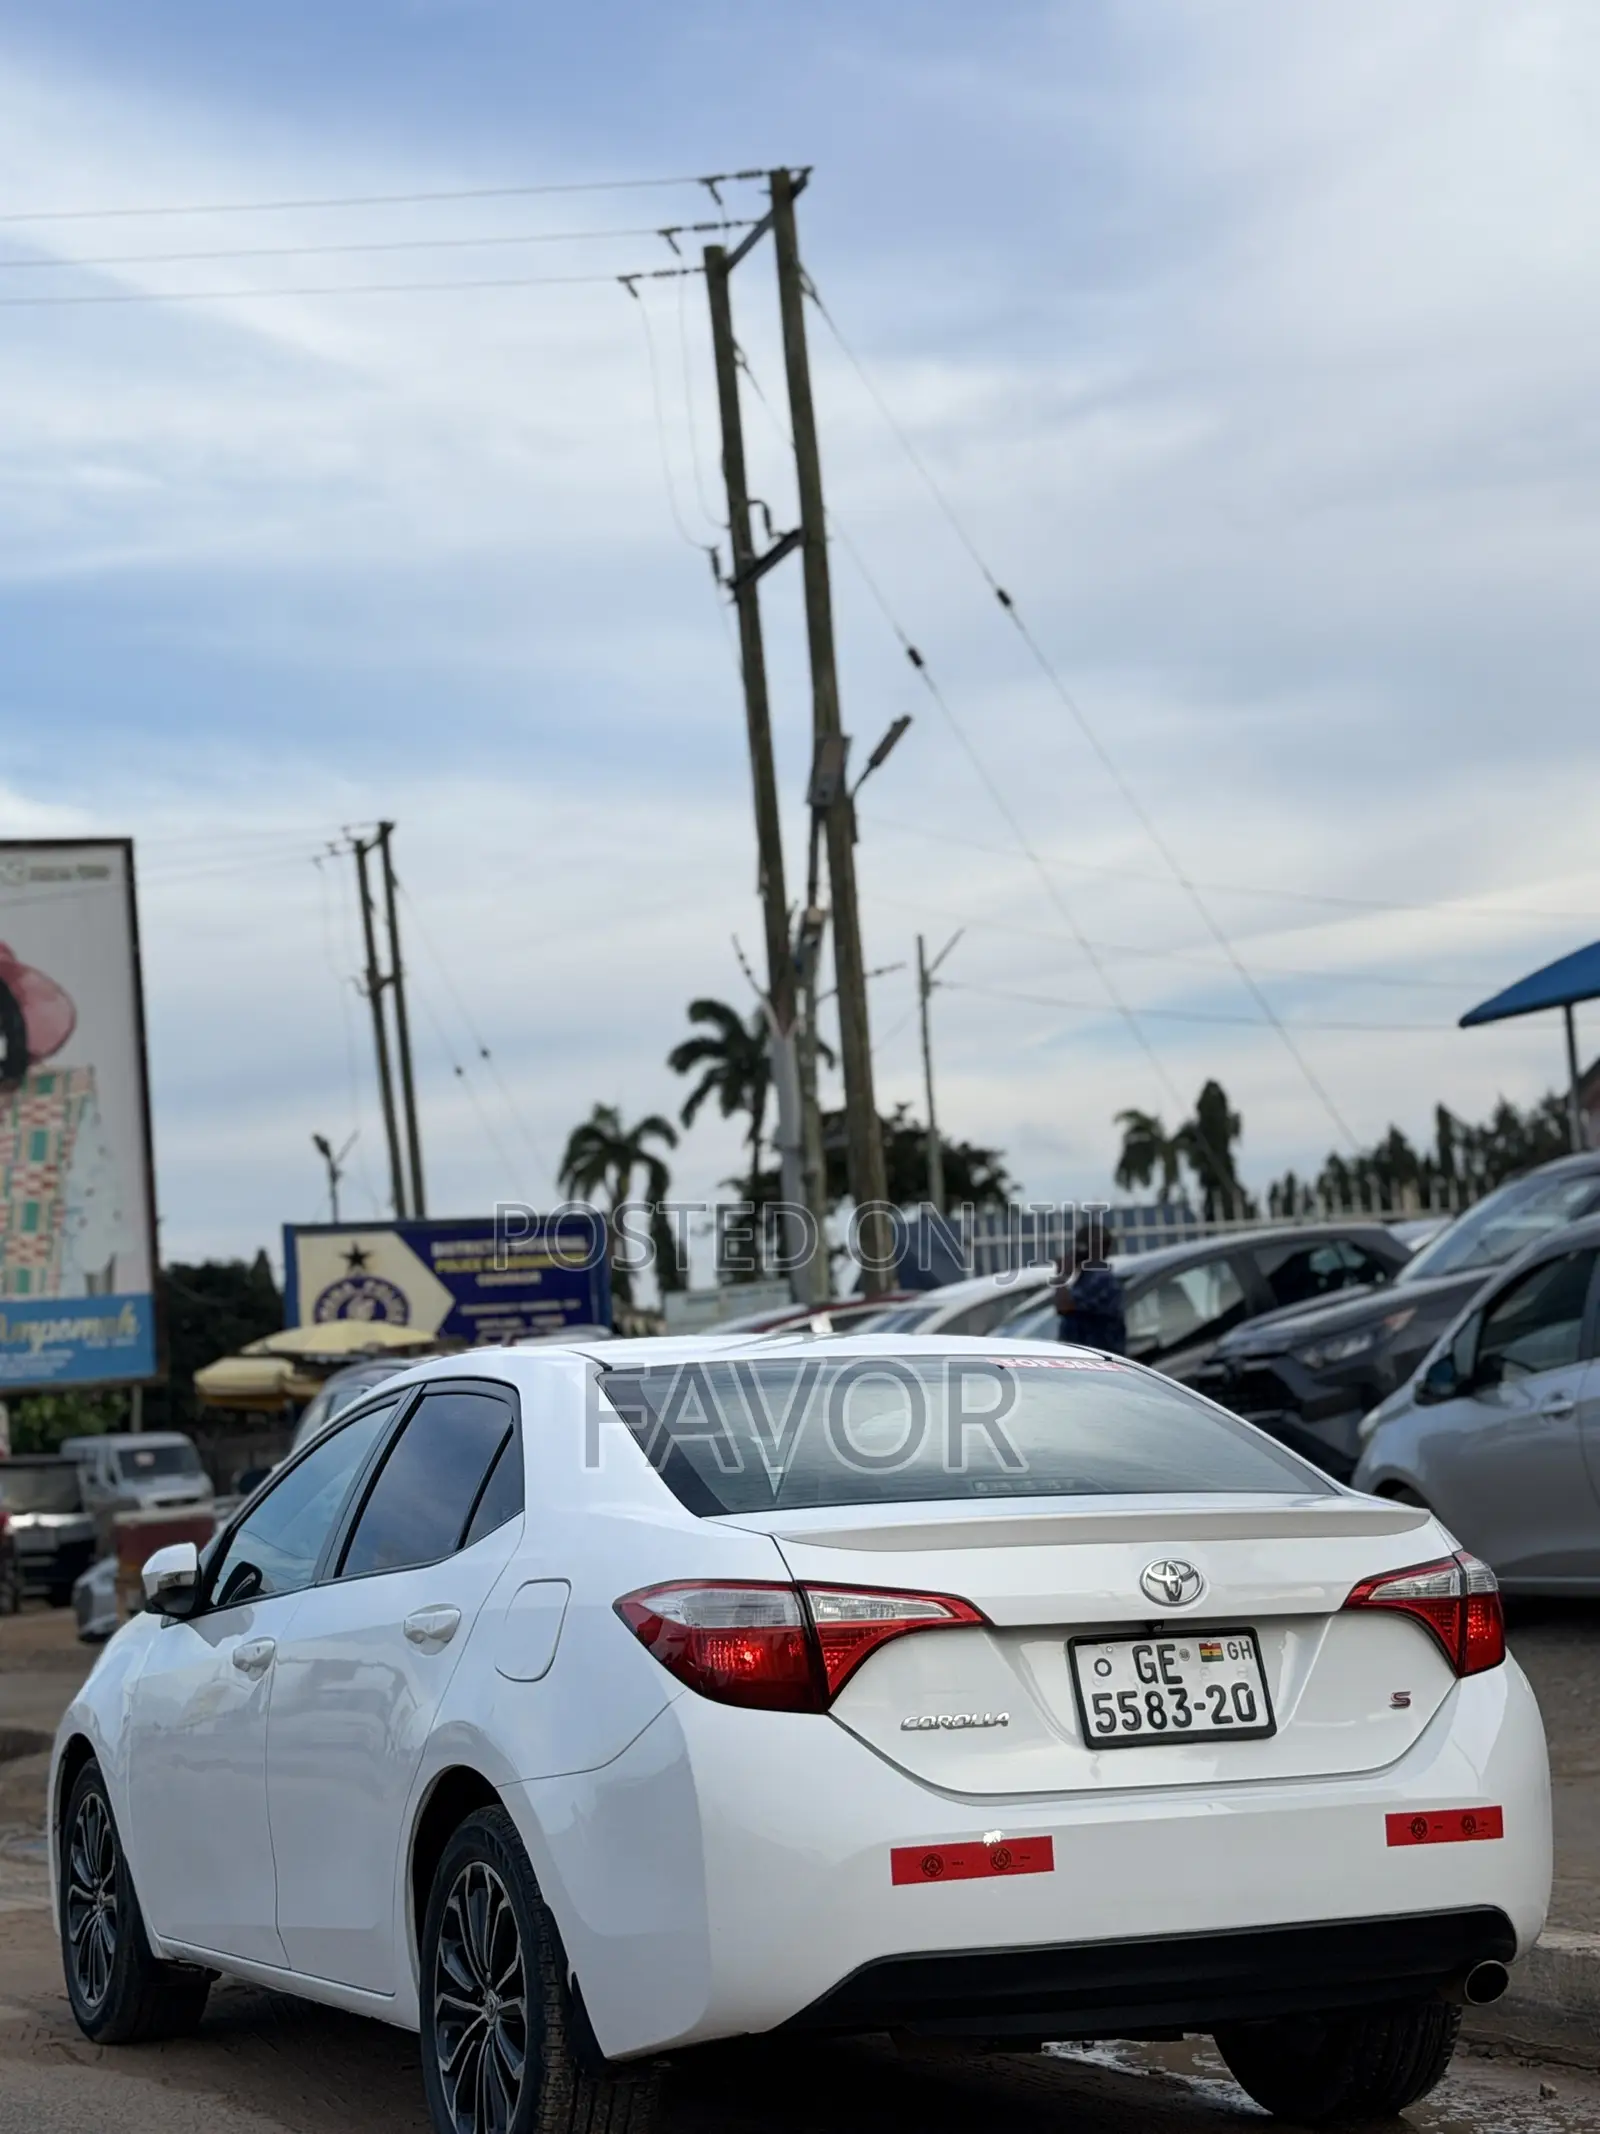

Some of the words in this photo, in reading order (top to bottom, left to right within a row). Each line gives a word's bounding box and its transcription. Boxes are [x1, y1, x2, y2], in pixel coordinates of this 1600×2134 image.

[1132, 1643, 1183, 1685] GE
[1227, 1640, 1254, 1660] GH
[1091, 1682, 1258, 1734] 5583-20
[1389, 1690, 1412, 1710] S
[900, 1712, 1010, 1731] COROLLA
